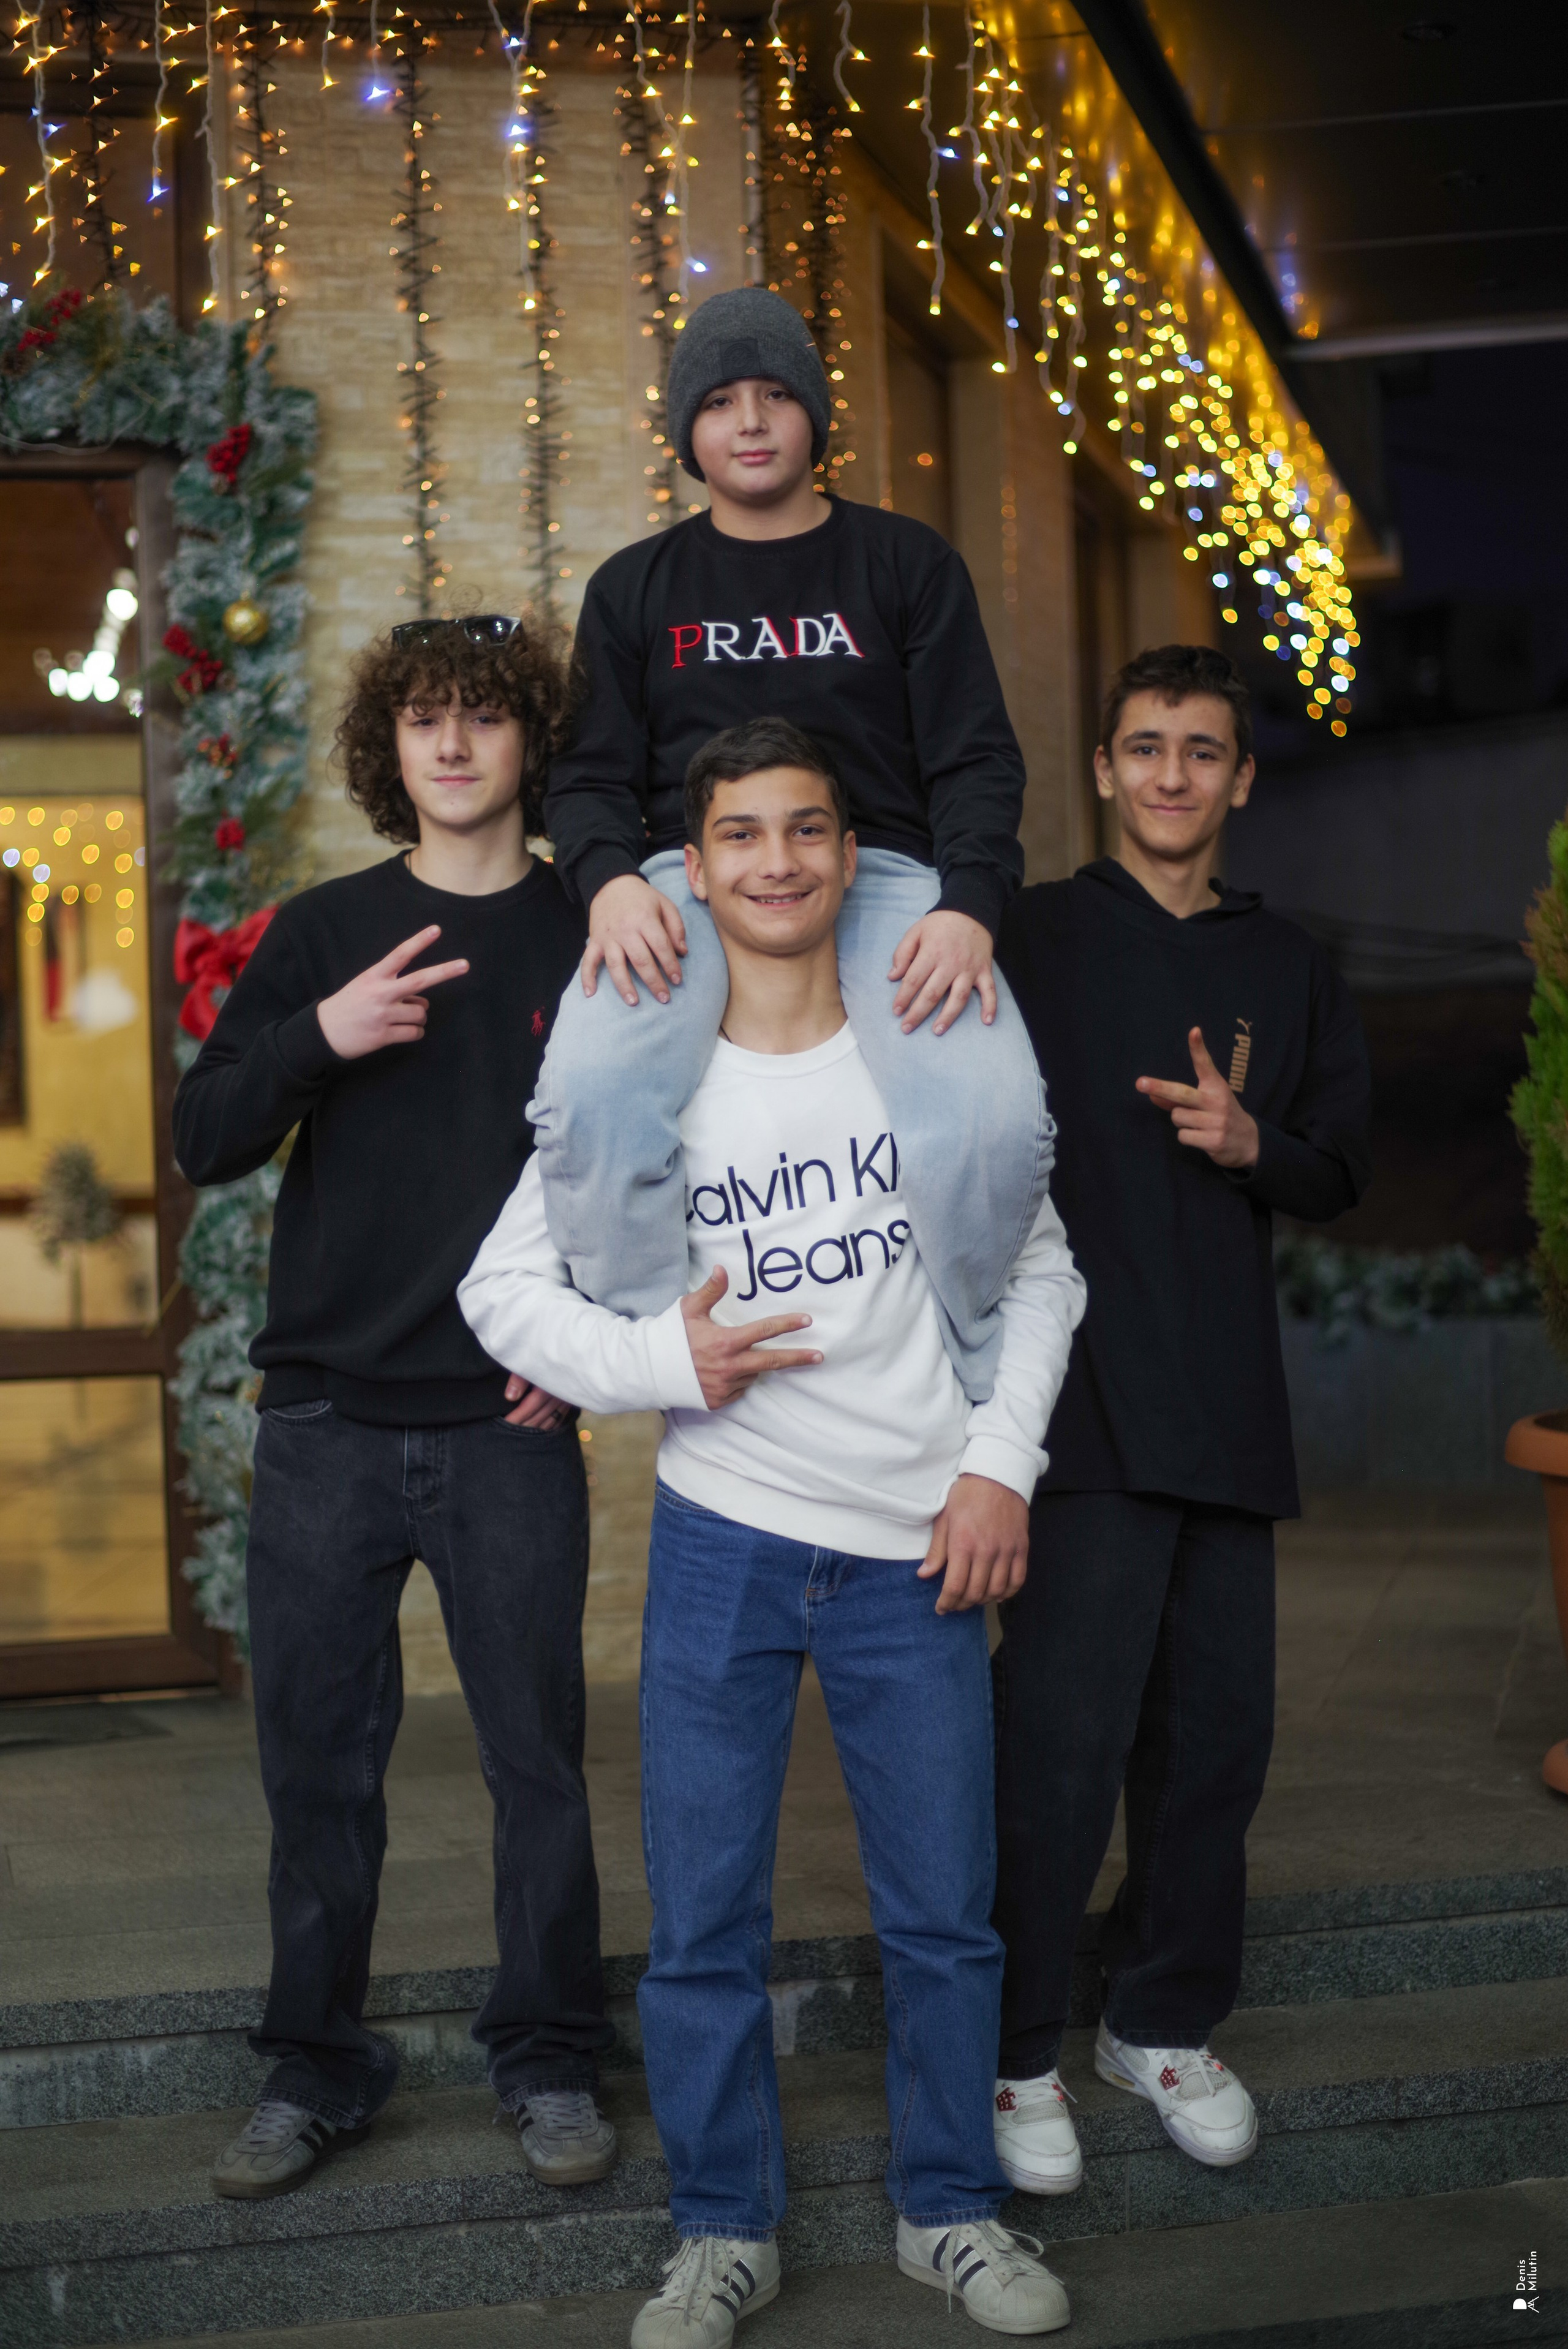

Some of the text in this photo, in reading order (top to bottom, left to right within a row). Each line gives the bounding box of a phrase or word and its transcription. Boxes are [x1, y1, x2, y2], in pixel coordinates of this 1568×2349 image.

[668, 613, 865, 669] PRADA
[1229, 1033, 1251, 1093] PUMA
[685, 1132, 901, 1226] alvin Kl
[736, 1218, 910, 1301] Jeans
